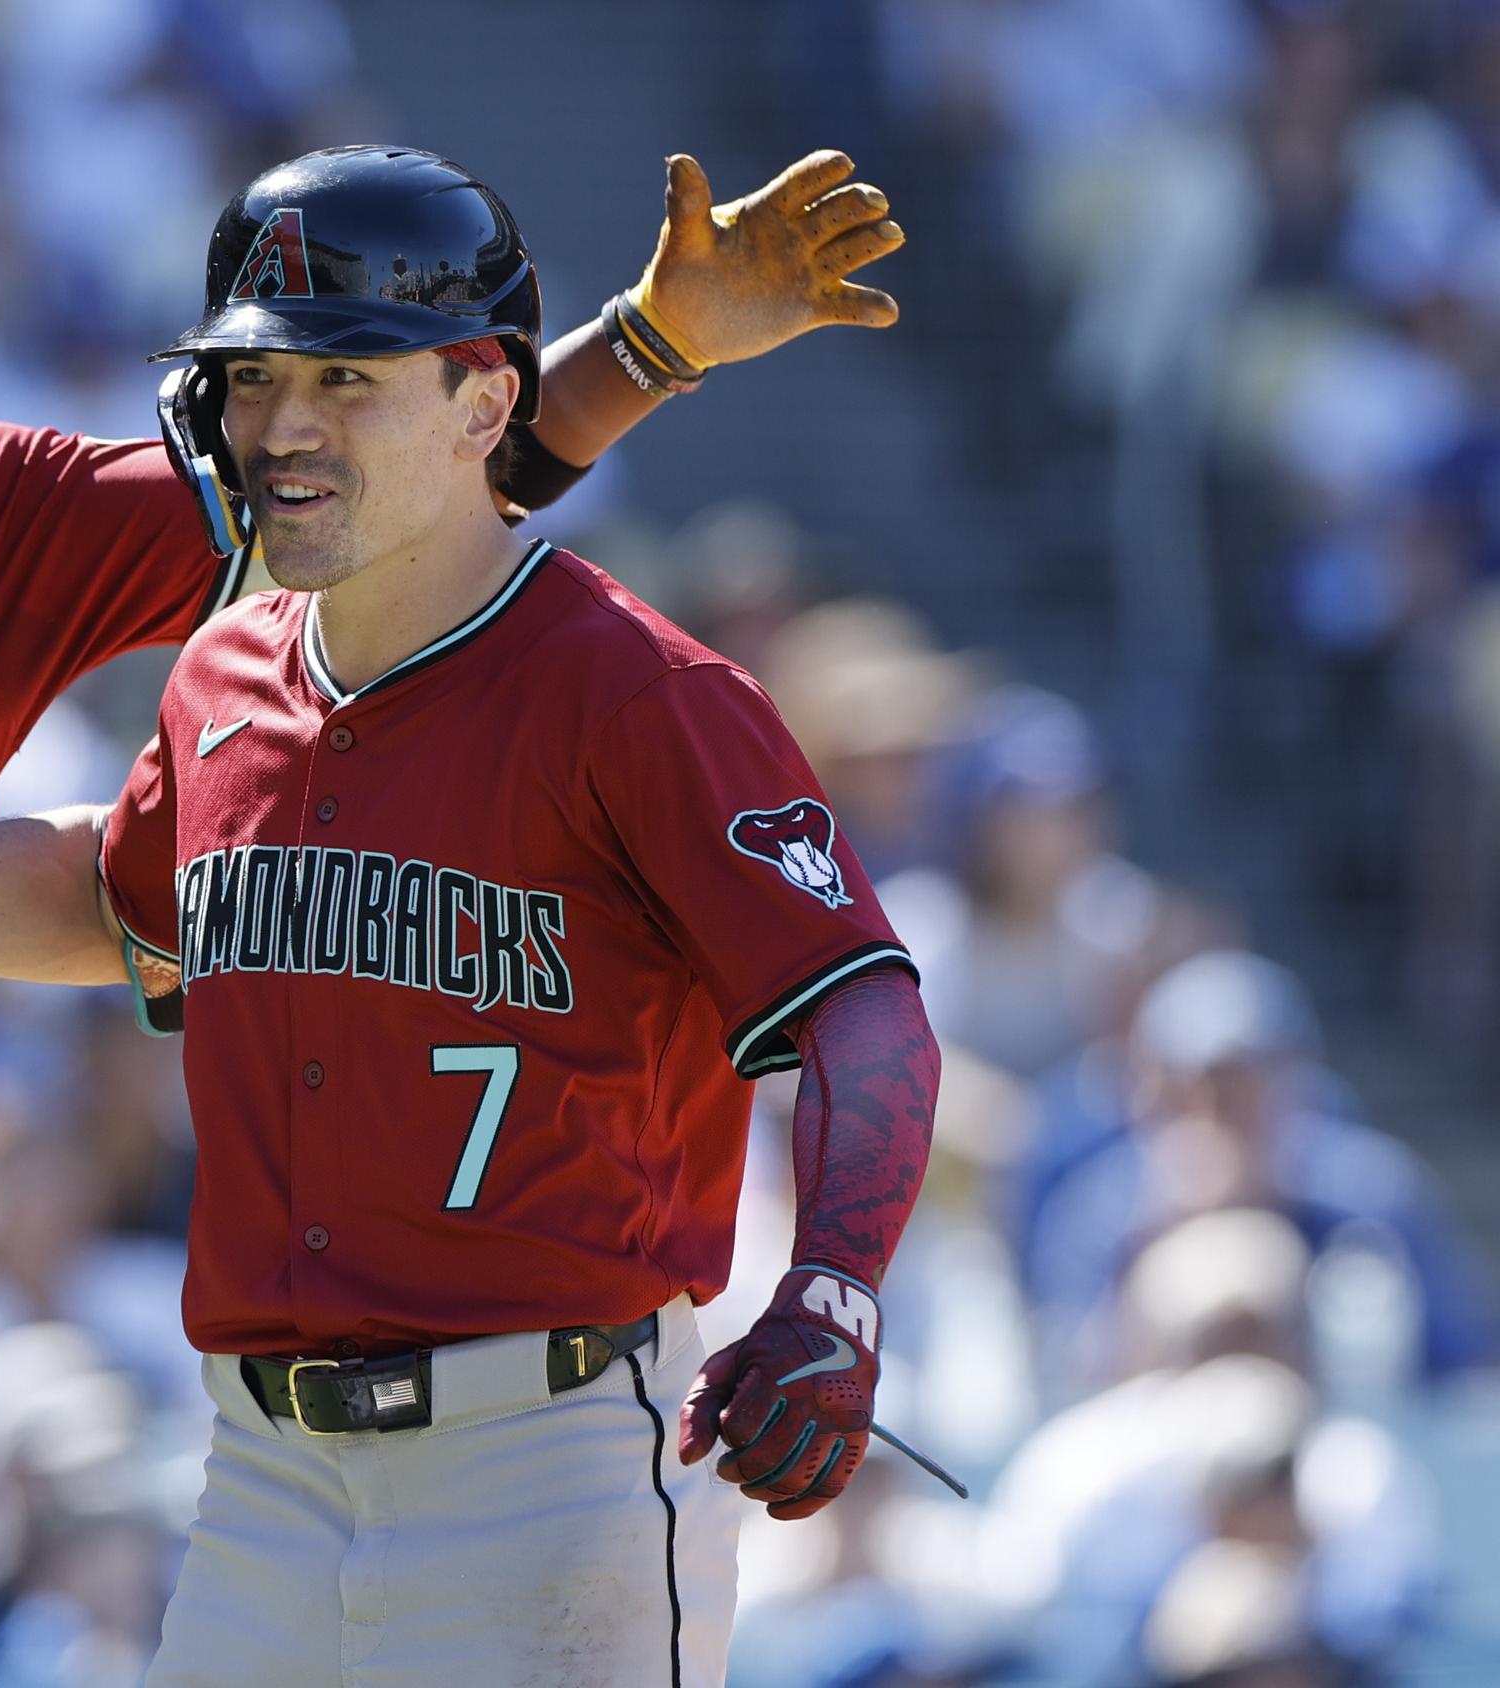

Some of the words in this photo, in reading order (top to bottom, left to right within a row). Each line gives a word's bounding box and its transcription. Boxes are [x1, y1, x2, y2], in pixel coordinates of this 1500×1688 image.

[611, 339, 653, 391] ROMANS
[429, 1041, 522, 1214] 7
[568, 1336, 586, 1377] 7
